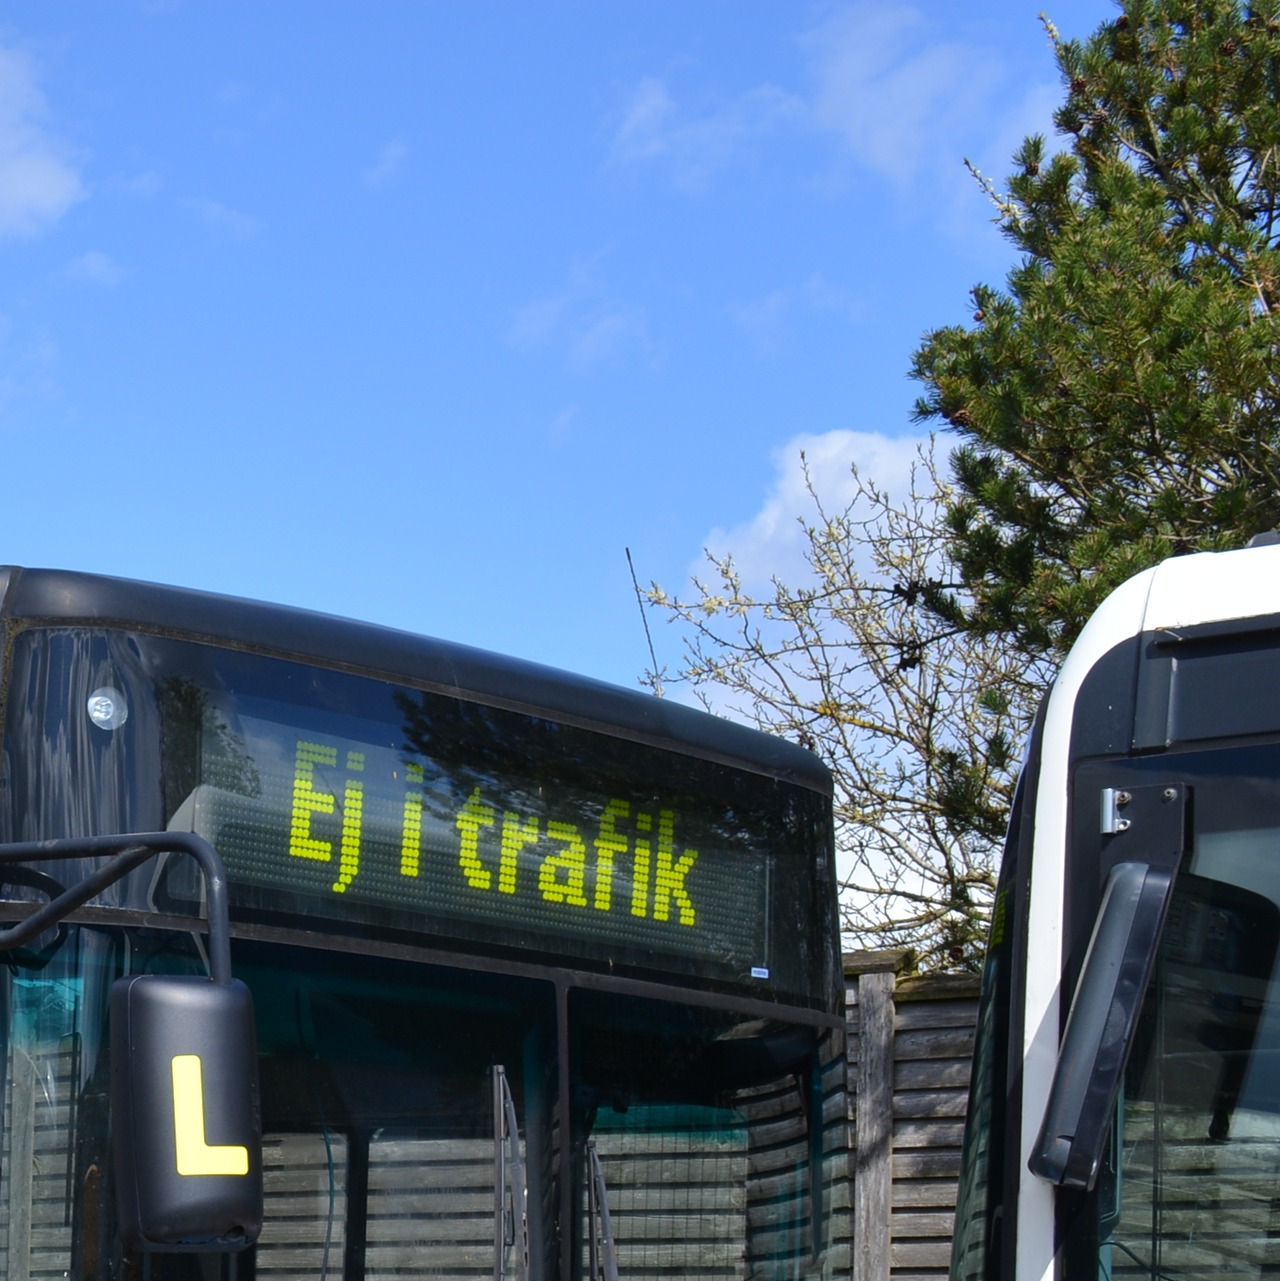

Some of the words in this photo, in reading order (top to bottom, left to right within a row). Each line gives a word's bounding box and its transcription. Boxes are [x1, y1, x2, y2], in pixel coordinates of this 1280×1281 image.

[290, 741, 364, 893] Ej
[401, 764, 424, 876] i
[456, 786, 698, 926] trafik
[171, 1054, 249, 1176] L
